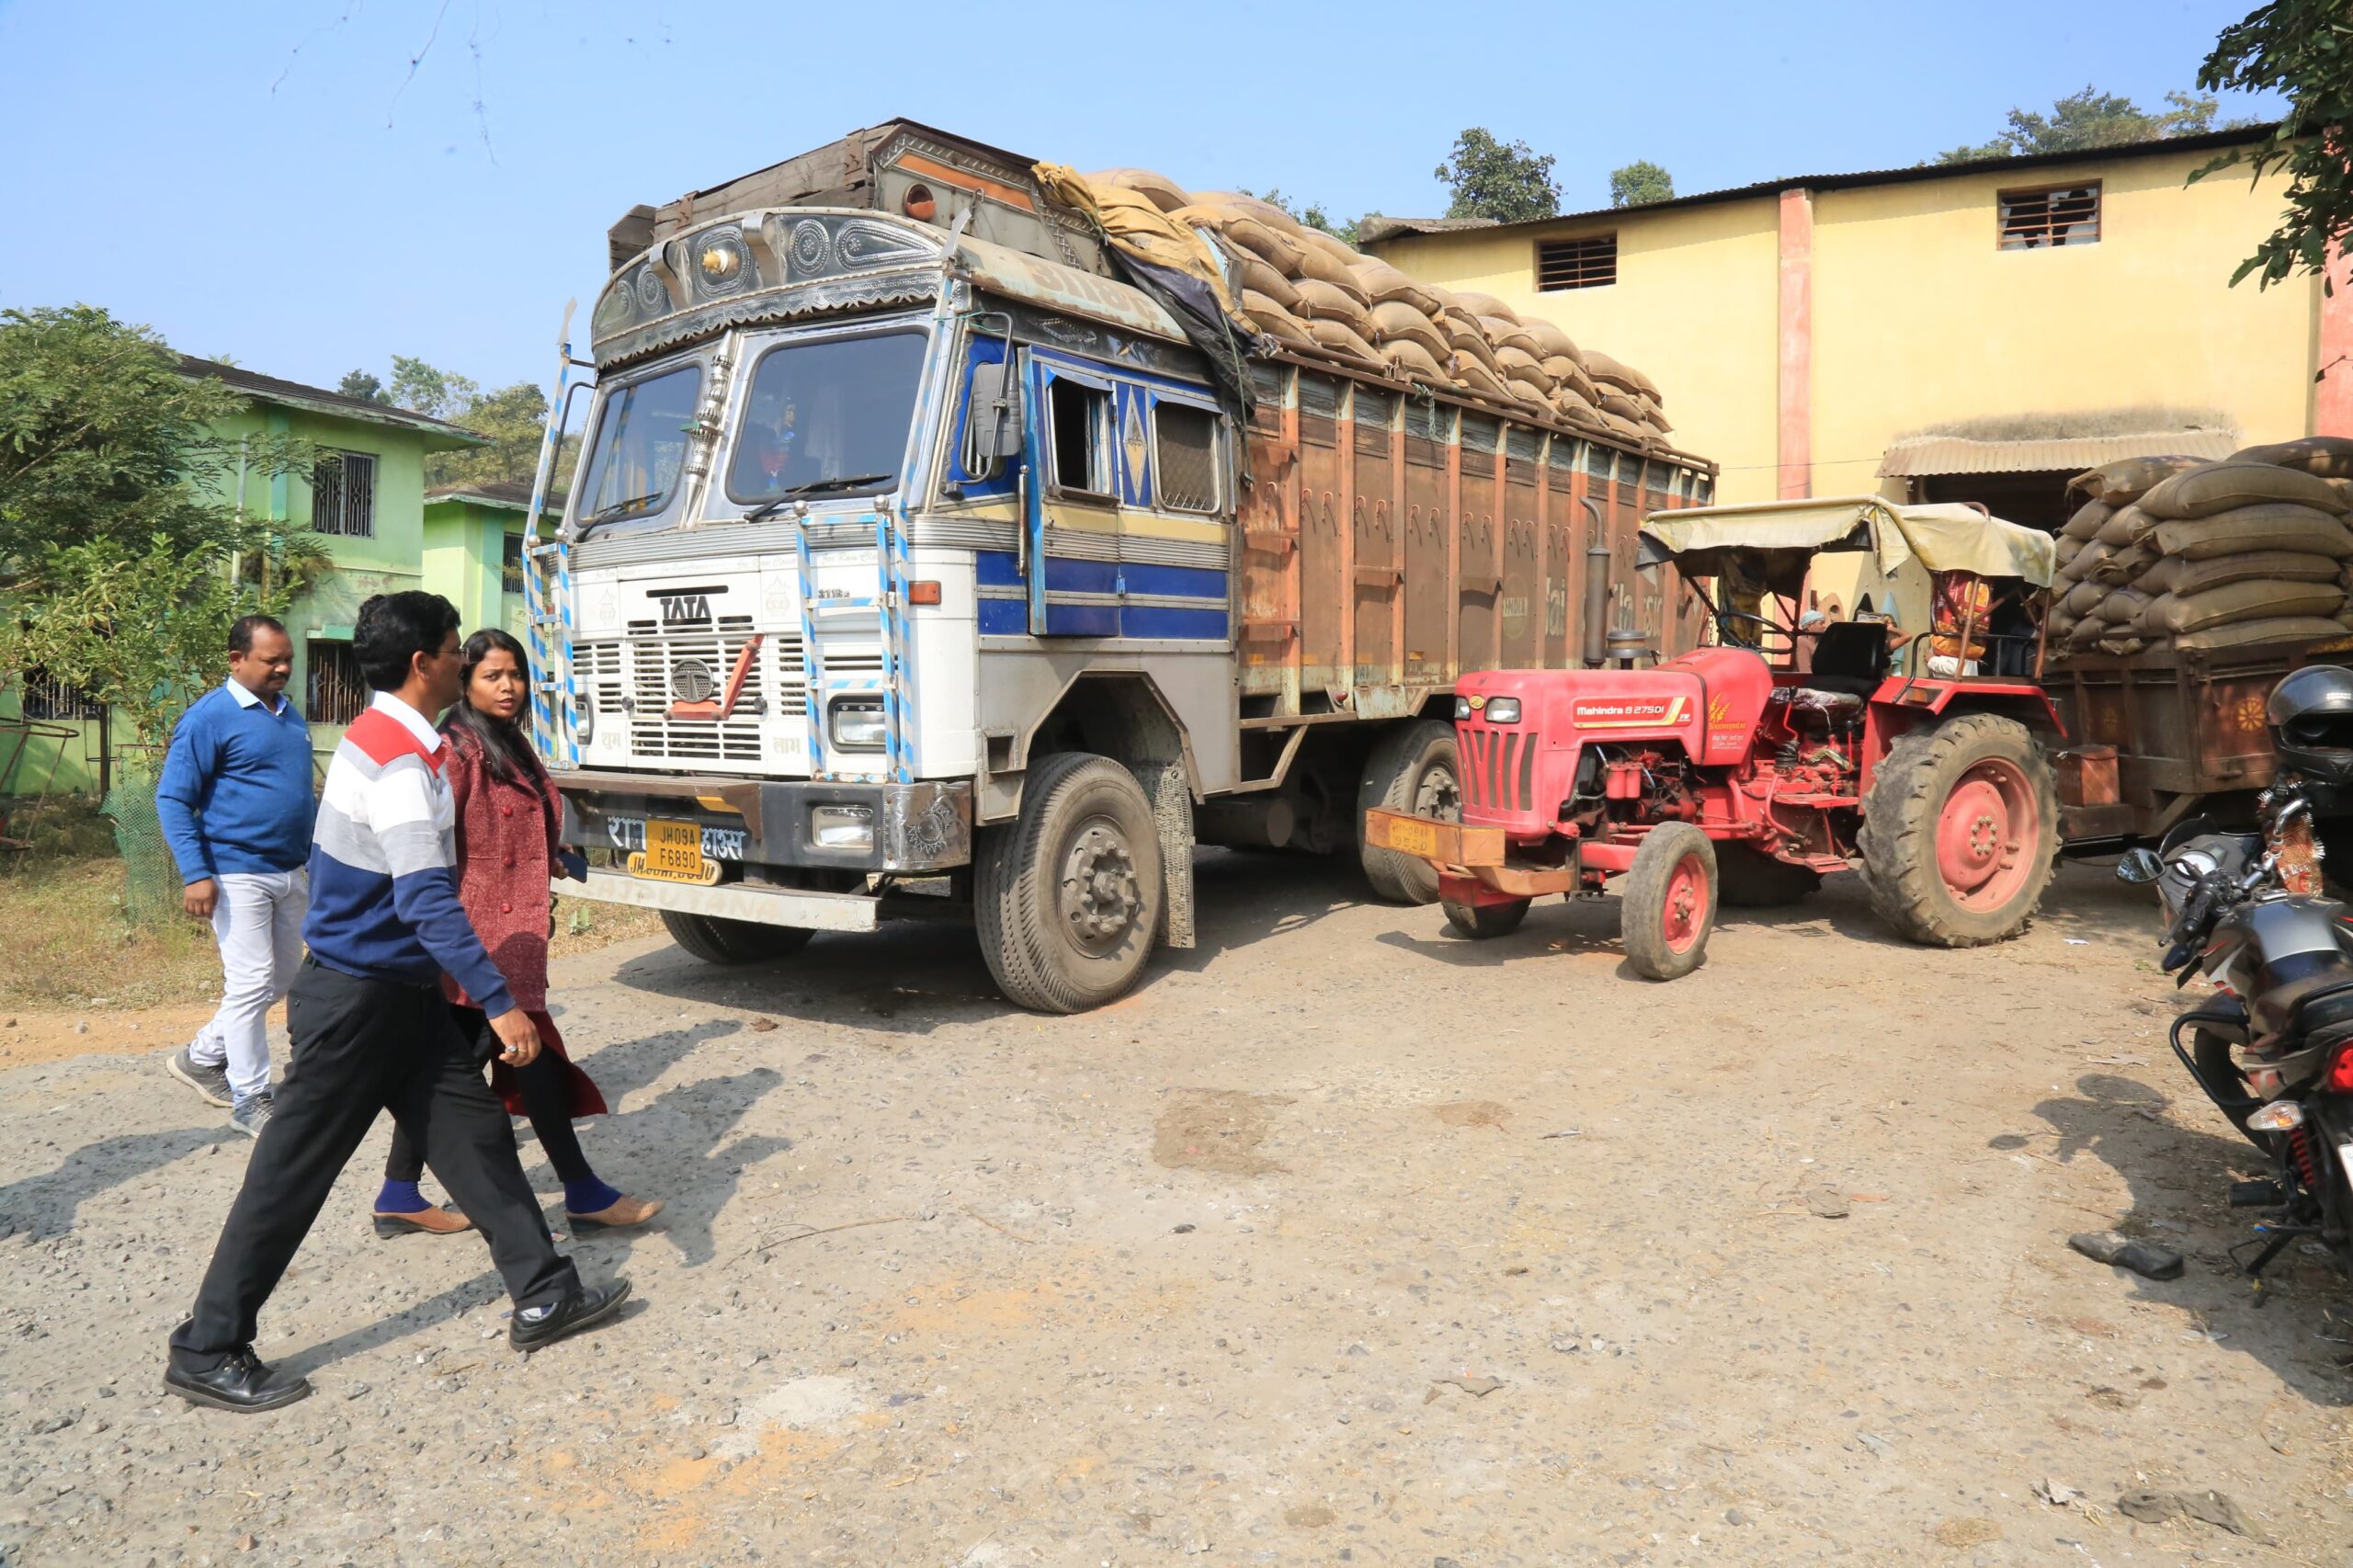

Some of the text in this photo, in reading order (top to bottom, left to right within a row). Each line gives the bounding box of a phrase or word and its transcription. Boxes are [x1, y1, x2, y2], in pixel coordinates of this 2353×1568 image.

[660, 596, 712, 619] TATA
[1577, 706, 1623, 716] Mahindra
[660, 847, 696, 869] F6890
